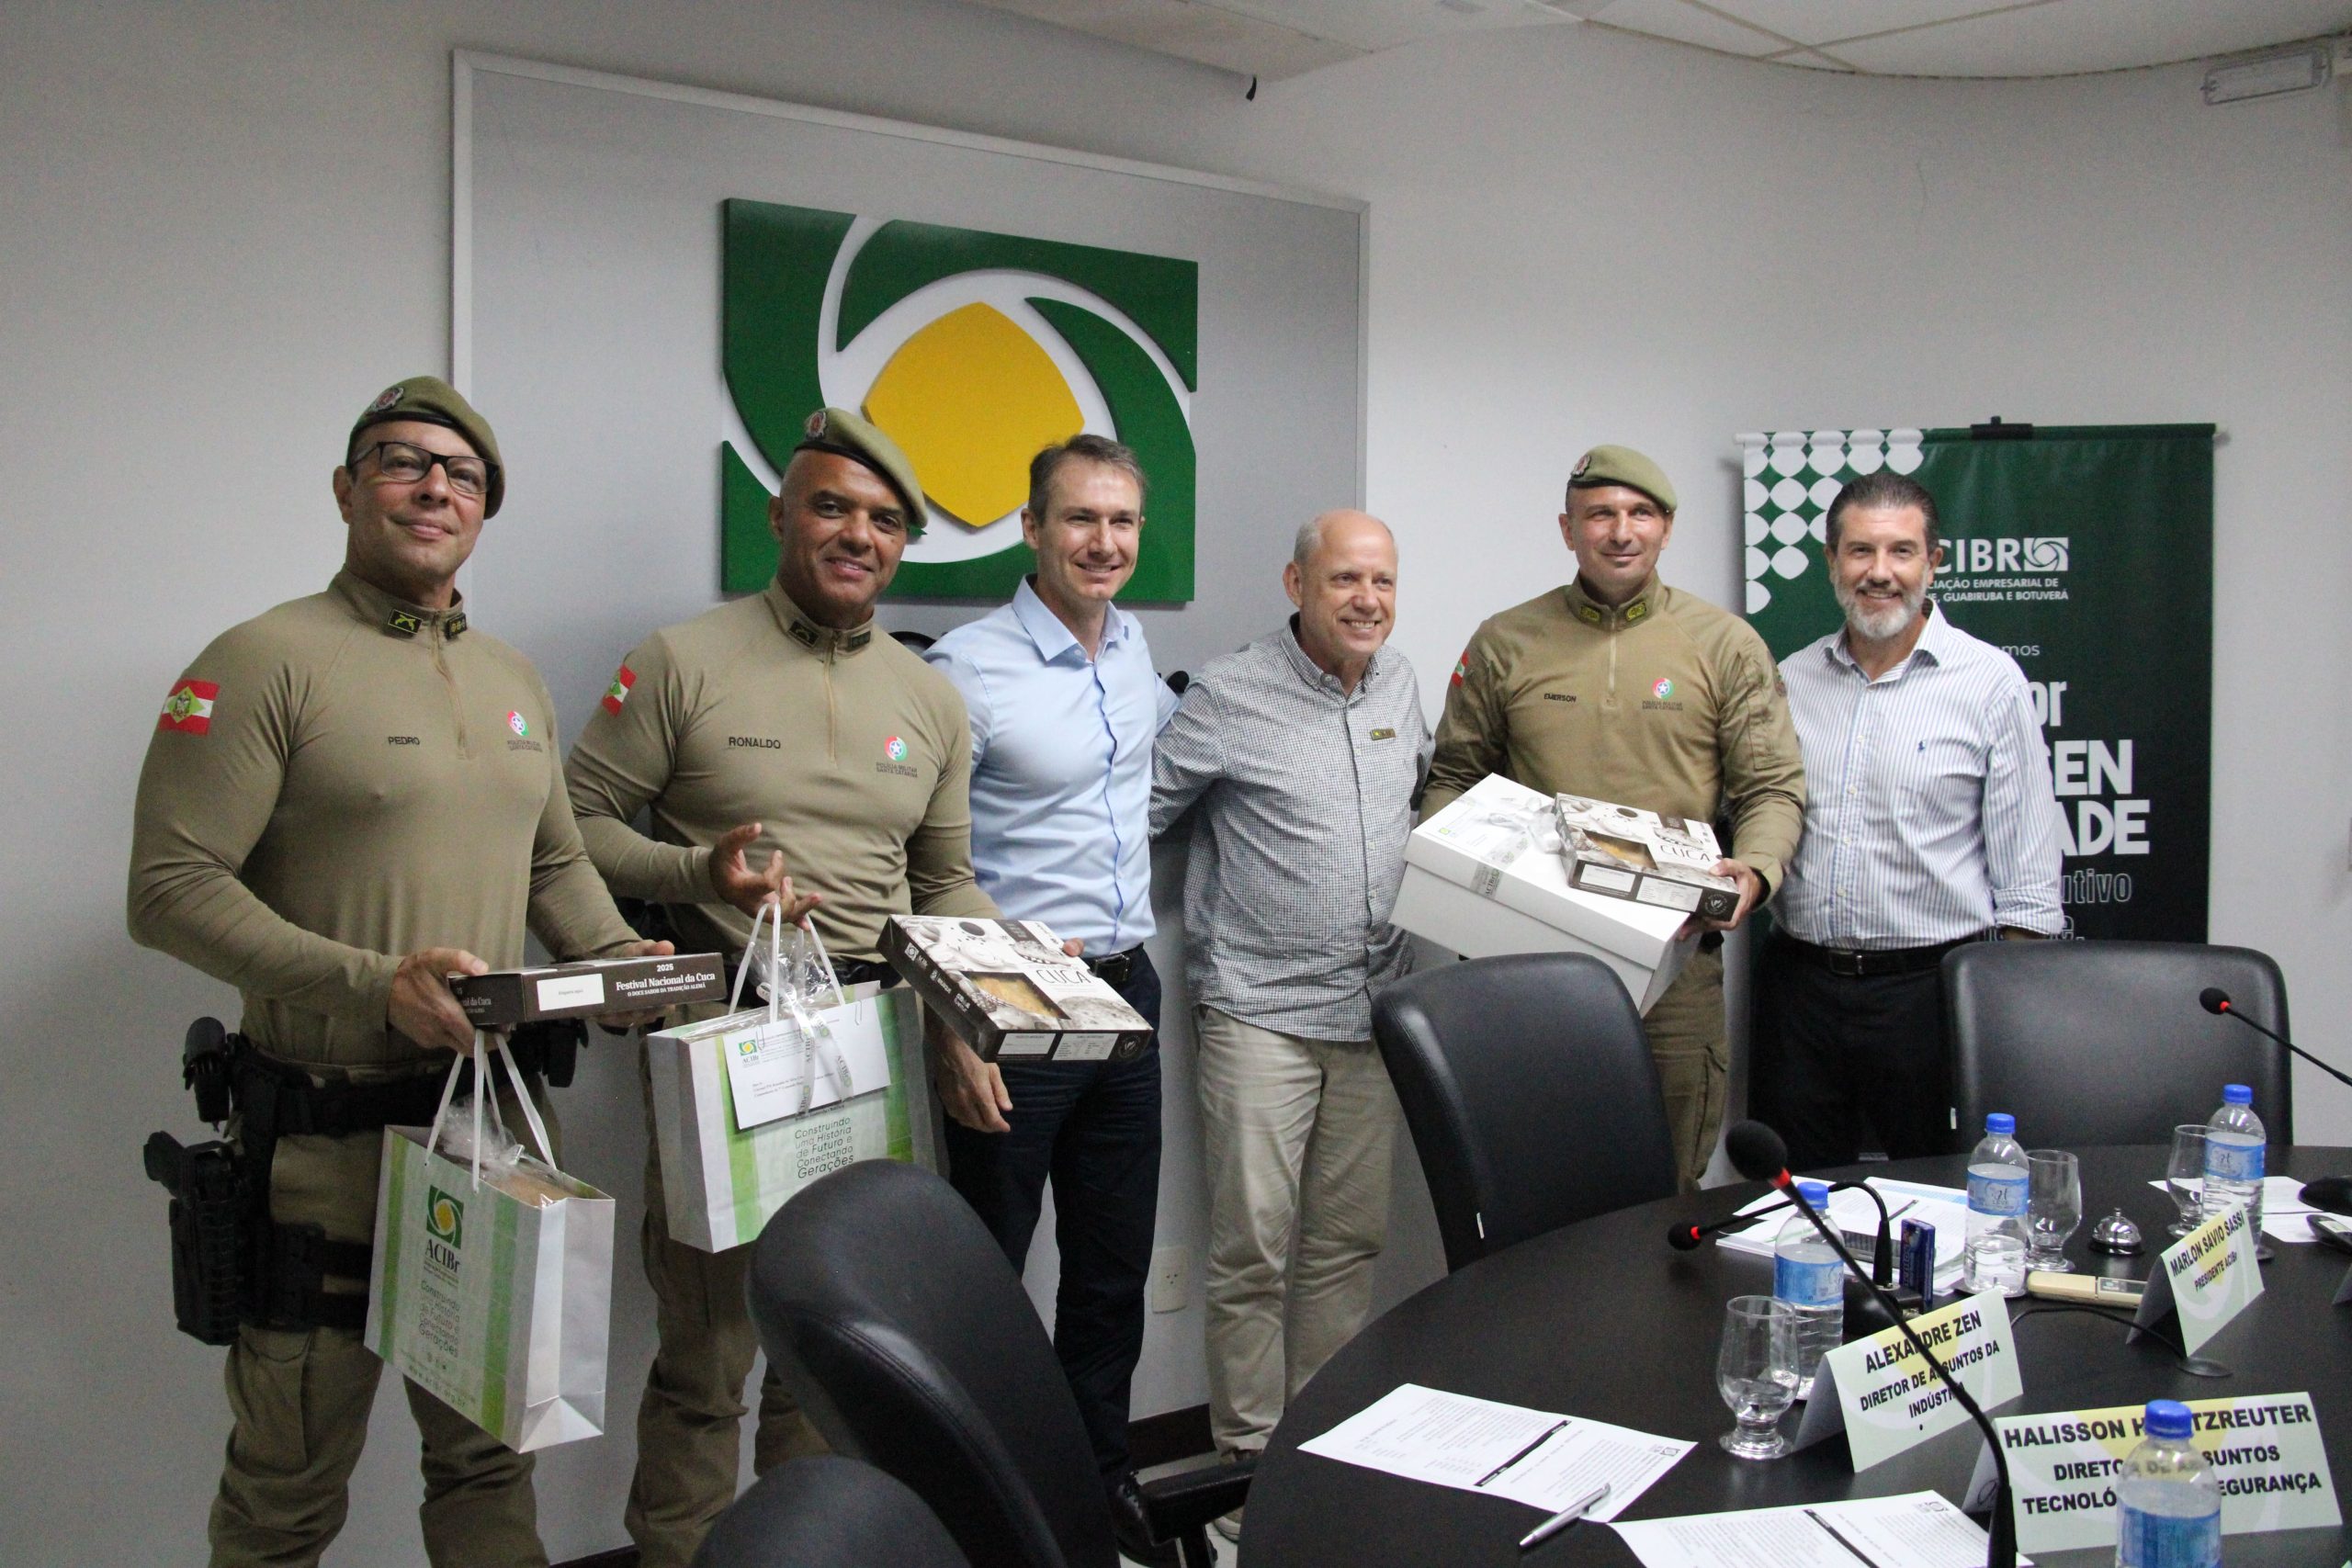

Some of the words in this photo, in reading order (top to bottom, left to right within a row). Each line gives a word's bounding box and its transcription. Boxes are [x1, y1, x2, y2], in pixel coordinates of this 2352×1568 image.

[1934, 537, 2021, 573] CIBR
[1973, 578, 2041, 589] EMPRESARIAL
[2045, 578, 2059, 588] DE
[1943, 592, 2004, 603] GUABIRUBA
[2007, 591, 2013, 601] E
[2016, 589, 2069, 601] BOTUVERÁ
[388, 736, 421, 745] PEDRO
[728, 736, 781, 750] RONALDO
[656, 964, 674, 972] 2025
[1035, 969, 1091, 984] CUCA
[616, 979, 648, 991] Festival
[649, 975, 684, 987] Nacional
[684, 974, 695, 983] da
[695, 973, 716, 982] Cuca
[795, 1117, 851, 1139] Construindo
[796, 1137, 815, 1149] uma
[817, 1126, 852, 1142] História
[797, 1149, 809, 1158] de
[812, 1139, 843, 1154] Futuro
[846, 1135, 853, 1144] e
[797, 1145, 854, 1168] Conectando
[797, 1155, 854, 1179] Gerações
[425, 1238, 460, 1272] ACIBr
[2170, 1241, 2203, 1277] MARLON
[2202, 1225, 2225, 1253] SÁVIO
[2223, 1211, 2245, 1236] SASSI
[2194, 1259, 2225, 1292] PRESIDENTE
[1953, 1310, 1983, 1337] ZEN
[1860, 1379, 1910, 1412] DIRETOR
[1911, 1371, 1927, 1389] DE
[1929, 1346, 1984, 1383] ASUNTOS
[1984, 1339, 2000, 1358] DA
[1909, 1382, 1964, 1418] INDÚST
[2004, 1419, 2127, 1449] HALISSON
[2132, 1404, 2312, 1438] HTZREUTER
[2217, 1472, 2323, 1497] EGURANÇA
